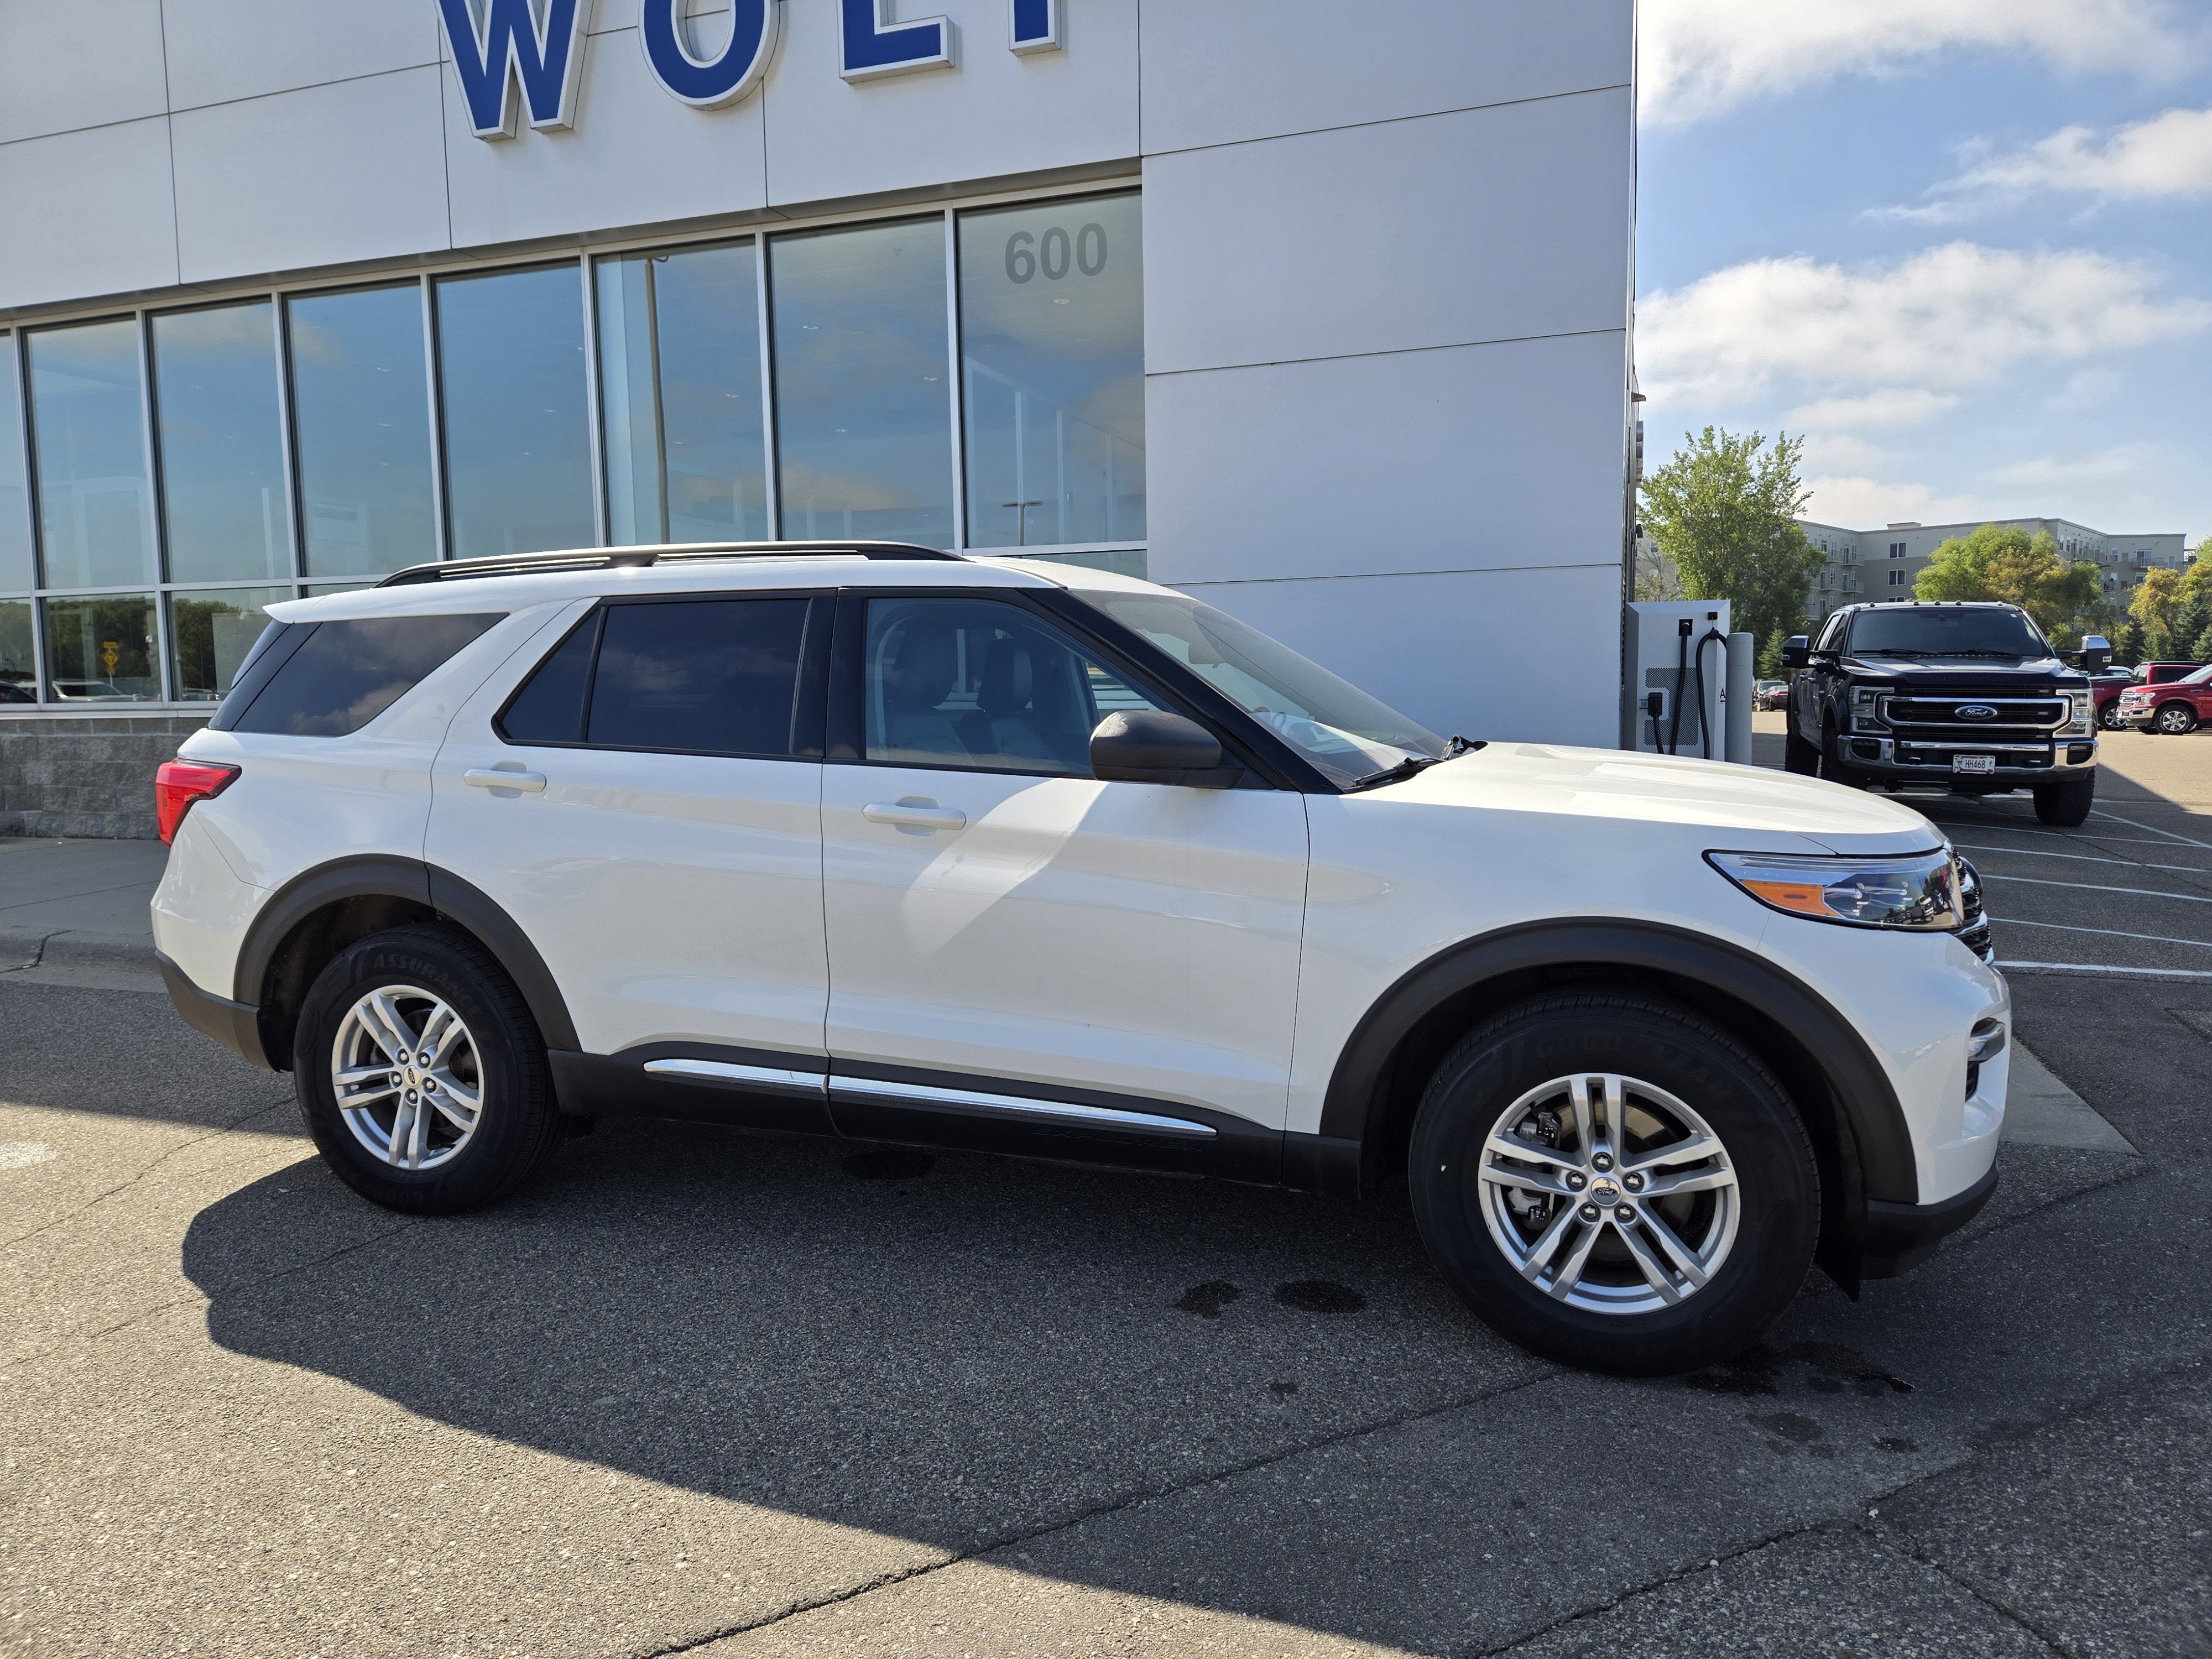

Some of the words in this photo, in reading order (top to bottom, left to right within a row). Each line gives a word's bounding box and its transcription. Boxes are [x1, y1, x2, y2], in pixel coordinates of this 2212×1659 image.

[434, 0, 1062, 142] WOL
[1005, 222, 1107, 284] 600
[374, 953, 483, 1018] ASSURANCE
